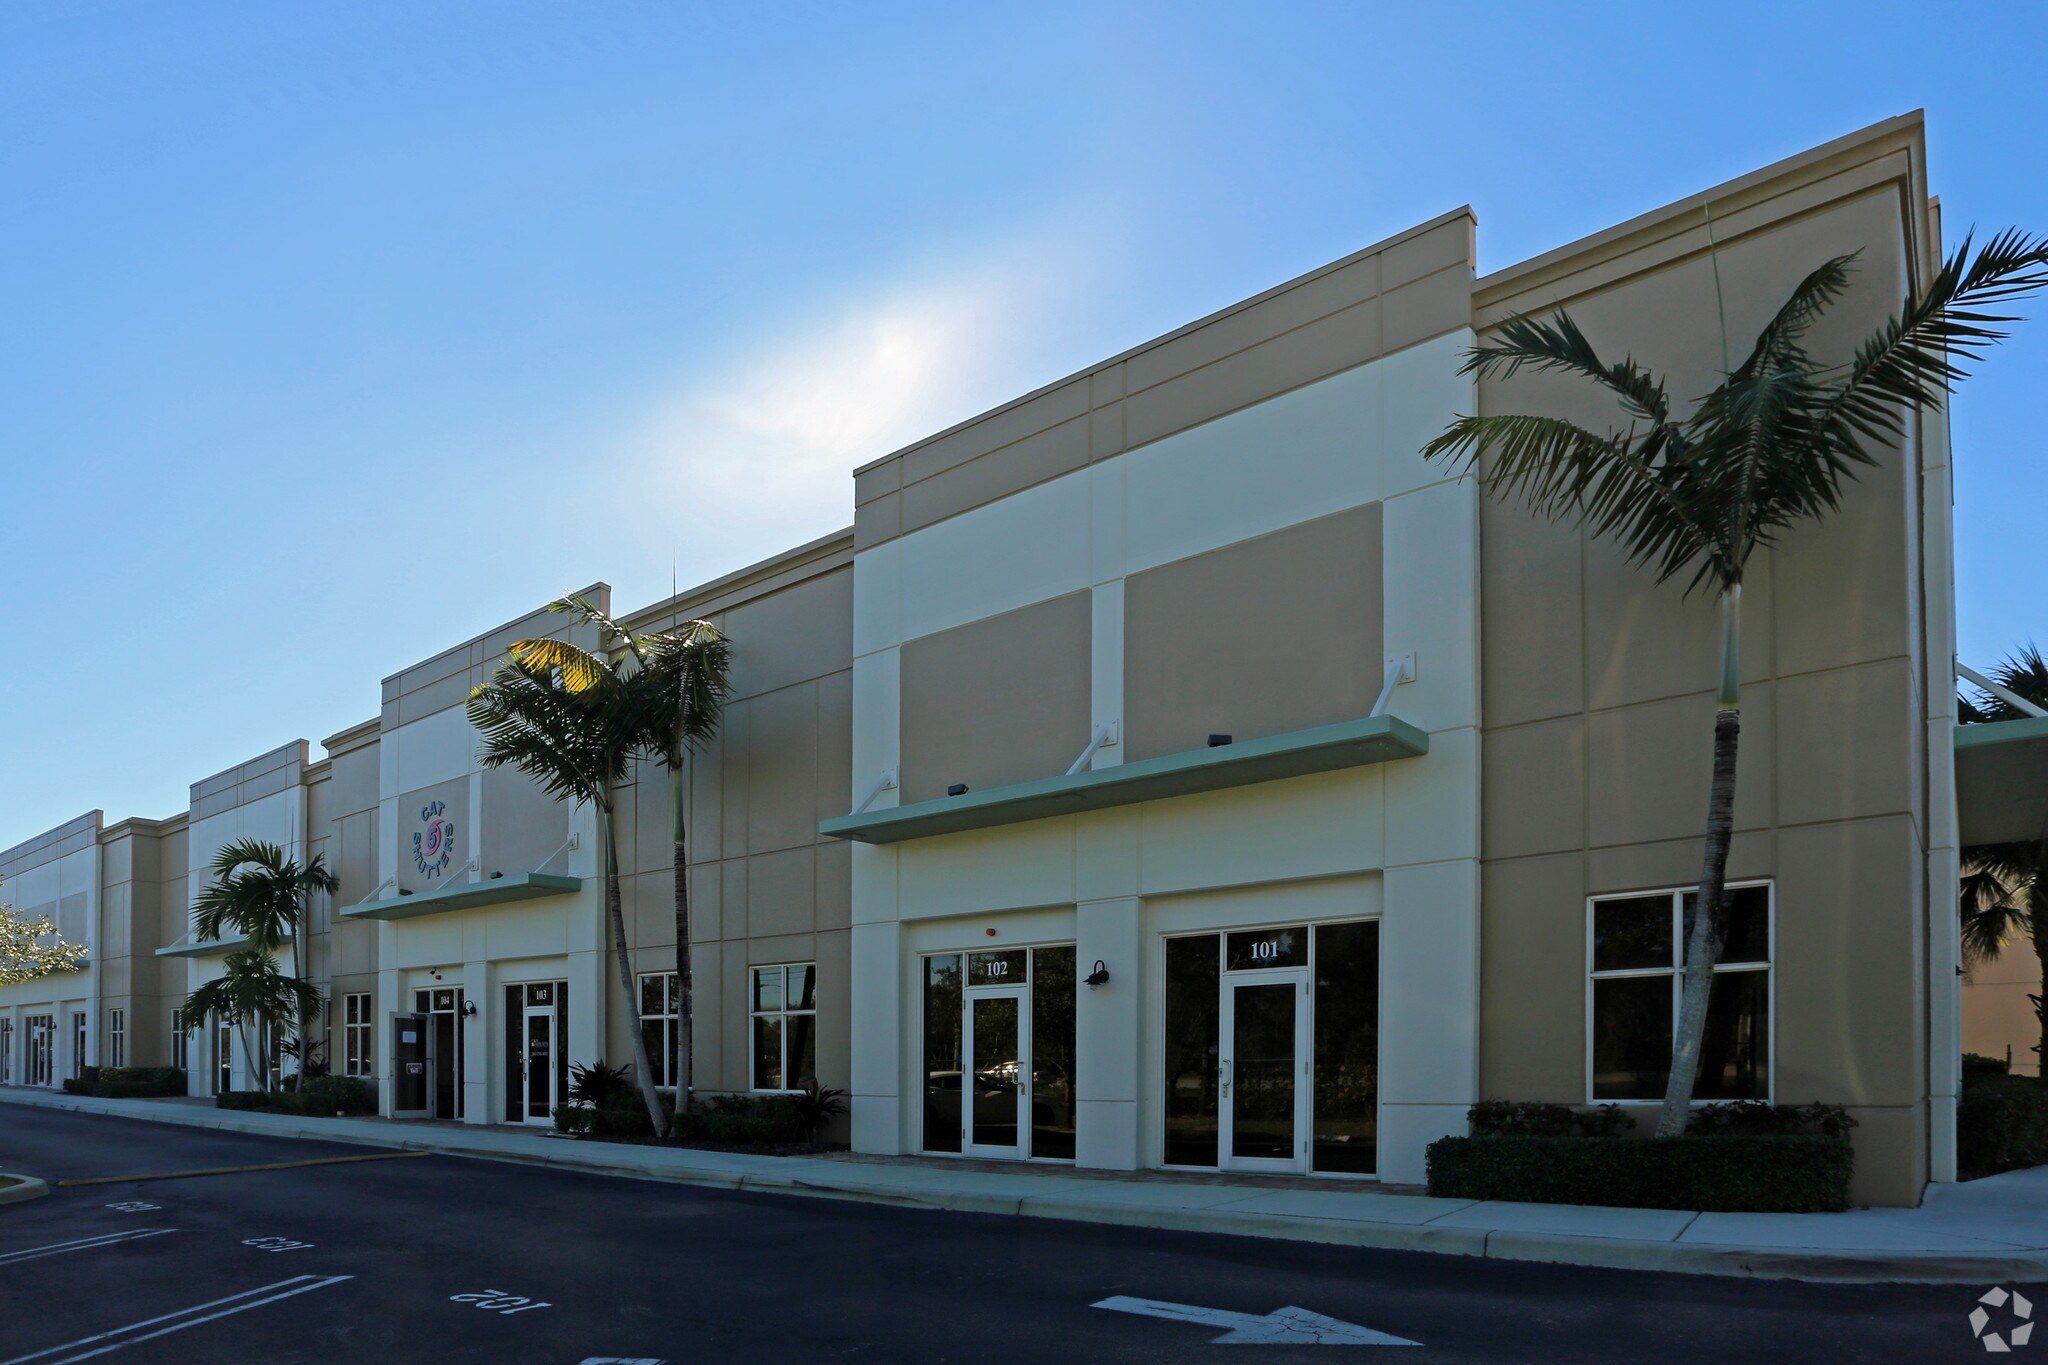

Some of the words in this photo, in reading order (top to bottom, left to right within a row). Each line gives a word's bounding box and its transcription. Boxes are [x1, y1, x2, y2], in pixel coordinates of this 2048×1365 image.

[422, 801, 446, 822] CAT
[428, 827, 438, 849] 5
[412, 823, 454, 879] SHUTTERS
[1251, 941, 1278, 959] 101
[986, 961, 1008, 976] 102
[536, 989, 547, 1000] 103
[241, 1236, 315, 1251] 103
[450, 1289, 553, 1314] 102
